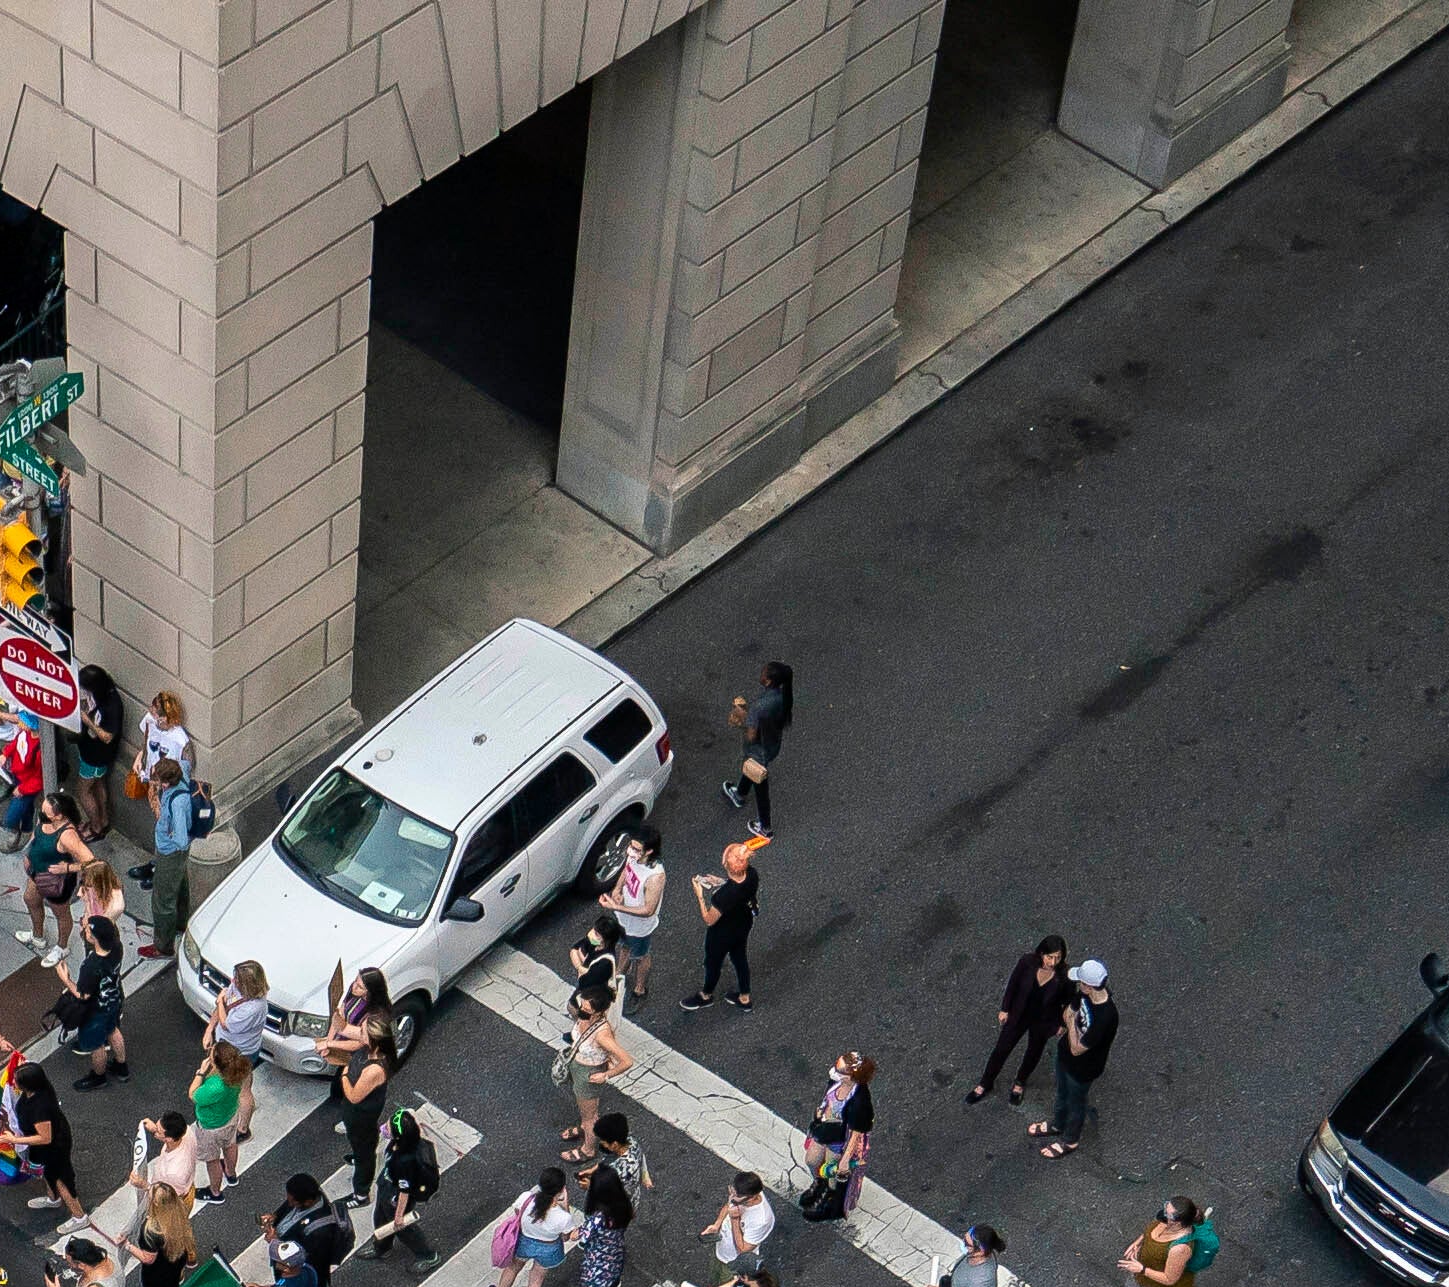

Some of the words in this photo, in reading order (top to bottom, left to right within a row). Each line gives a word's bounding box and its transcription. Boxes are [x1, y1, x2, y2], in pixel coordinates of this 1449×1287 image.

[67, 383, 80, 403] ST
[12, 453, 54, 492] STREET
[8, 644, 27, 662] DO
[36, 658, 65, 679] NOT
[15, 679, 62, 711] ENTER
